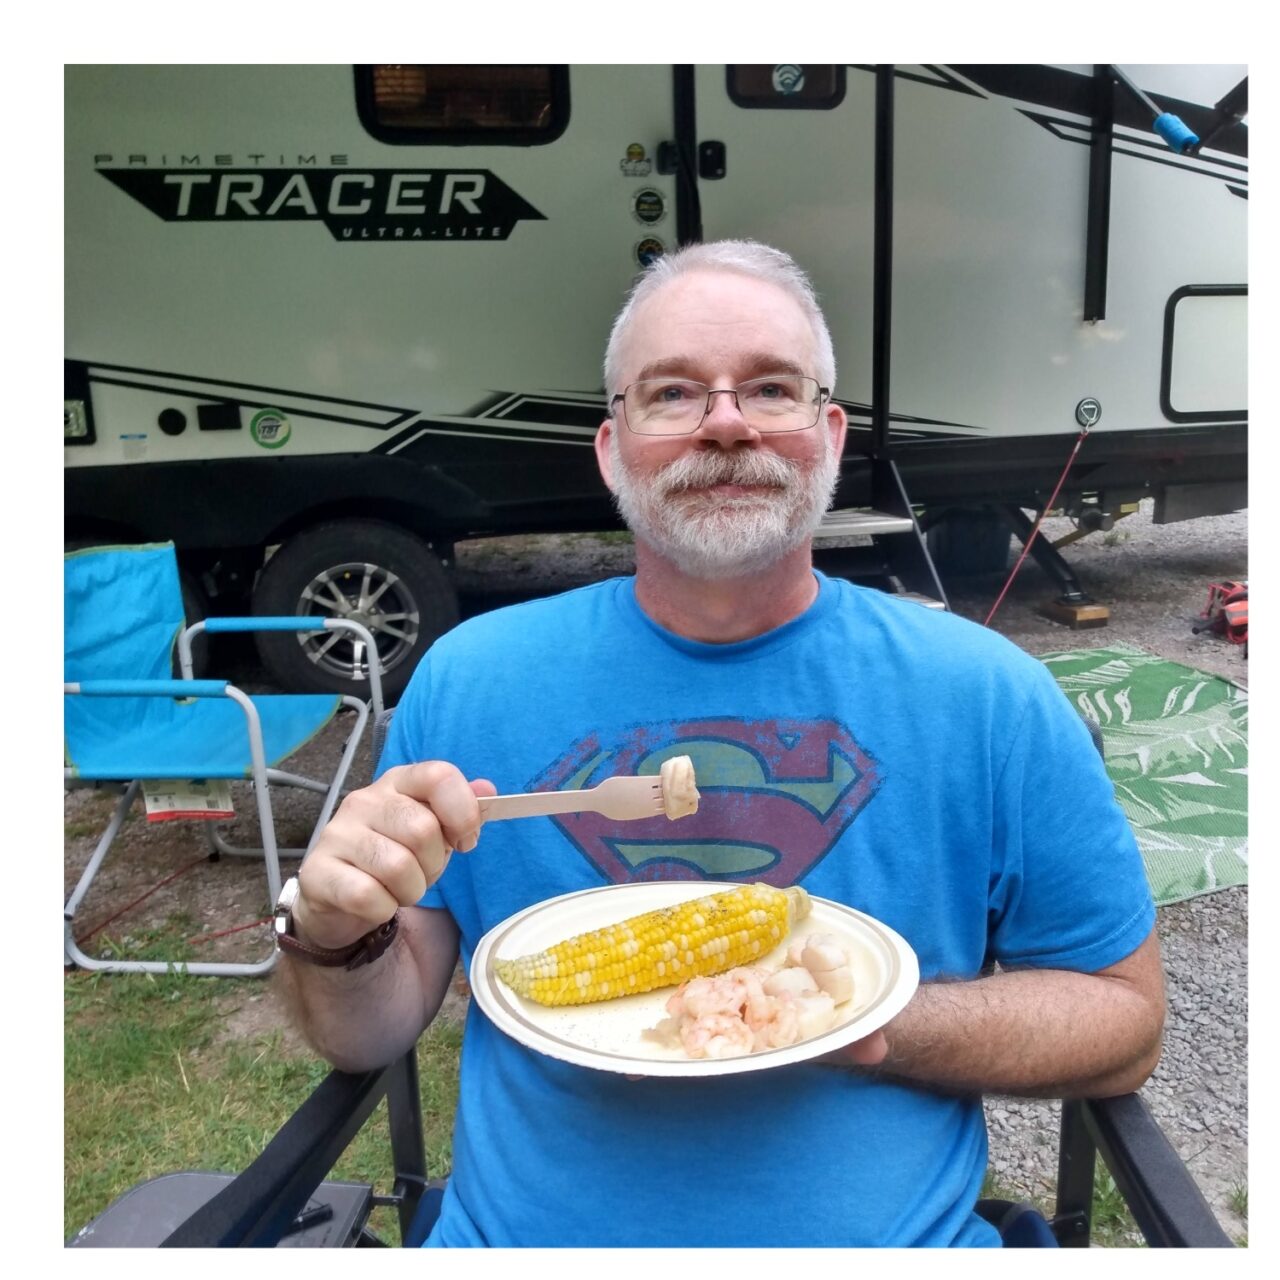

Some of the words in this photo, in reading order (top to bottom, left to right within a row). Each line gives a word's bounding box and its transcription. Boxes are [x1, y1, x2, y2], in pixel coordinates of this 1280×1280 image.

[94, 154, 349, 166] PRIMETIME
[163, 173, 487, 217] TRACER
[342, 226, 502, 239] ULTRA-LITE
